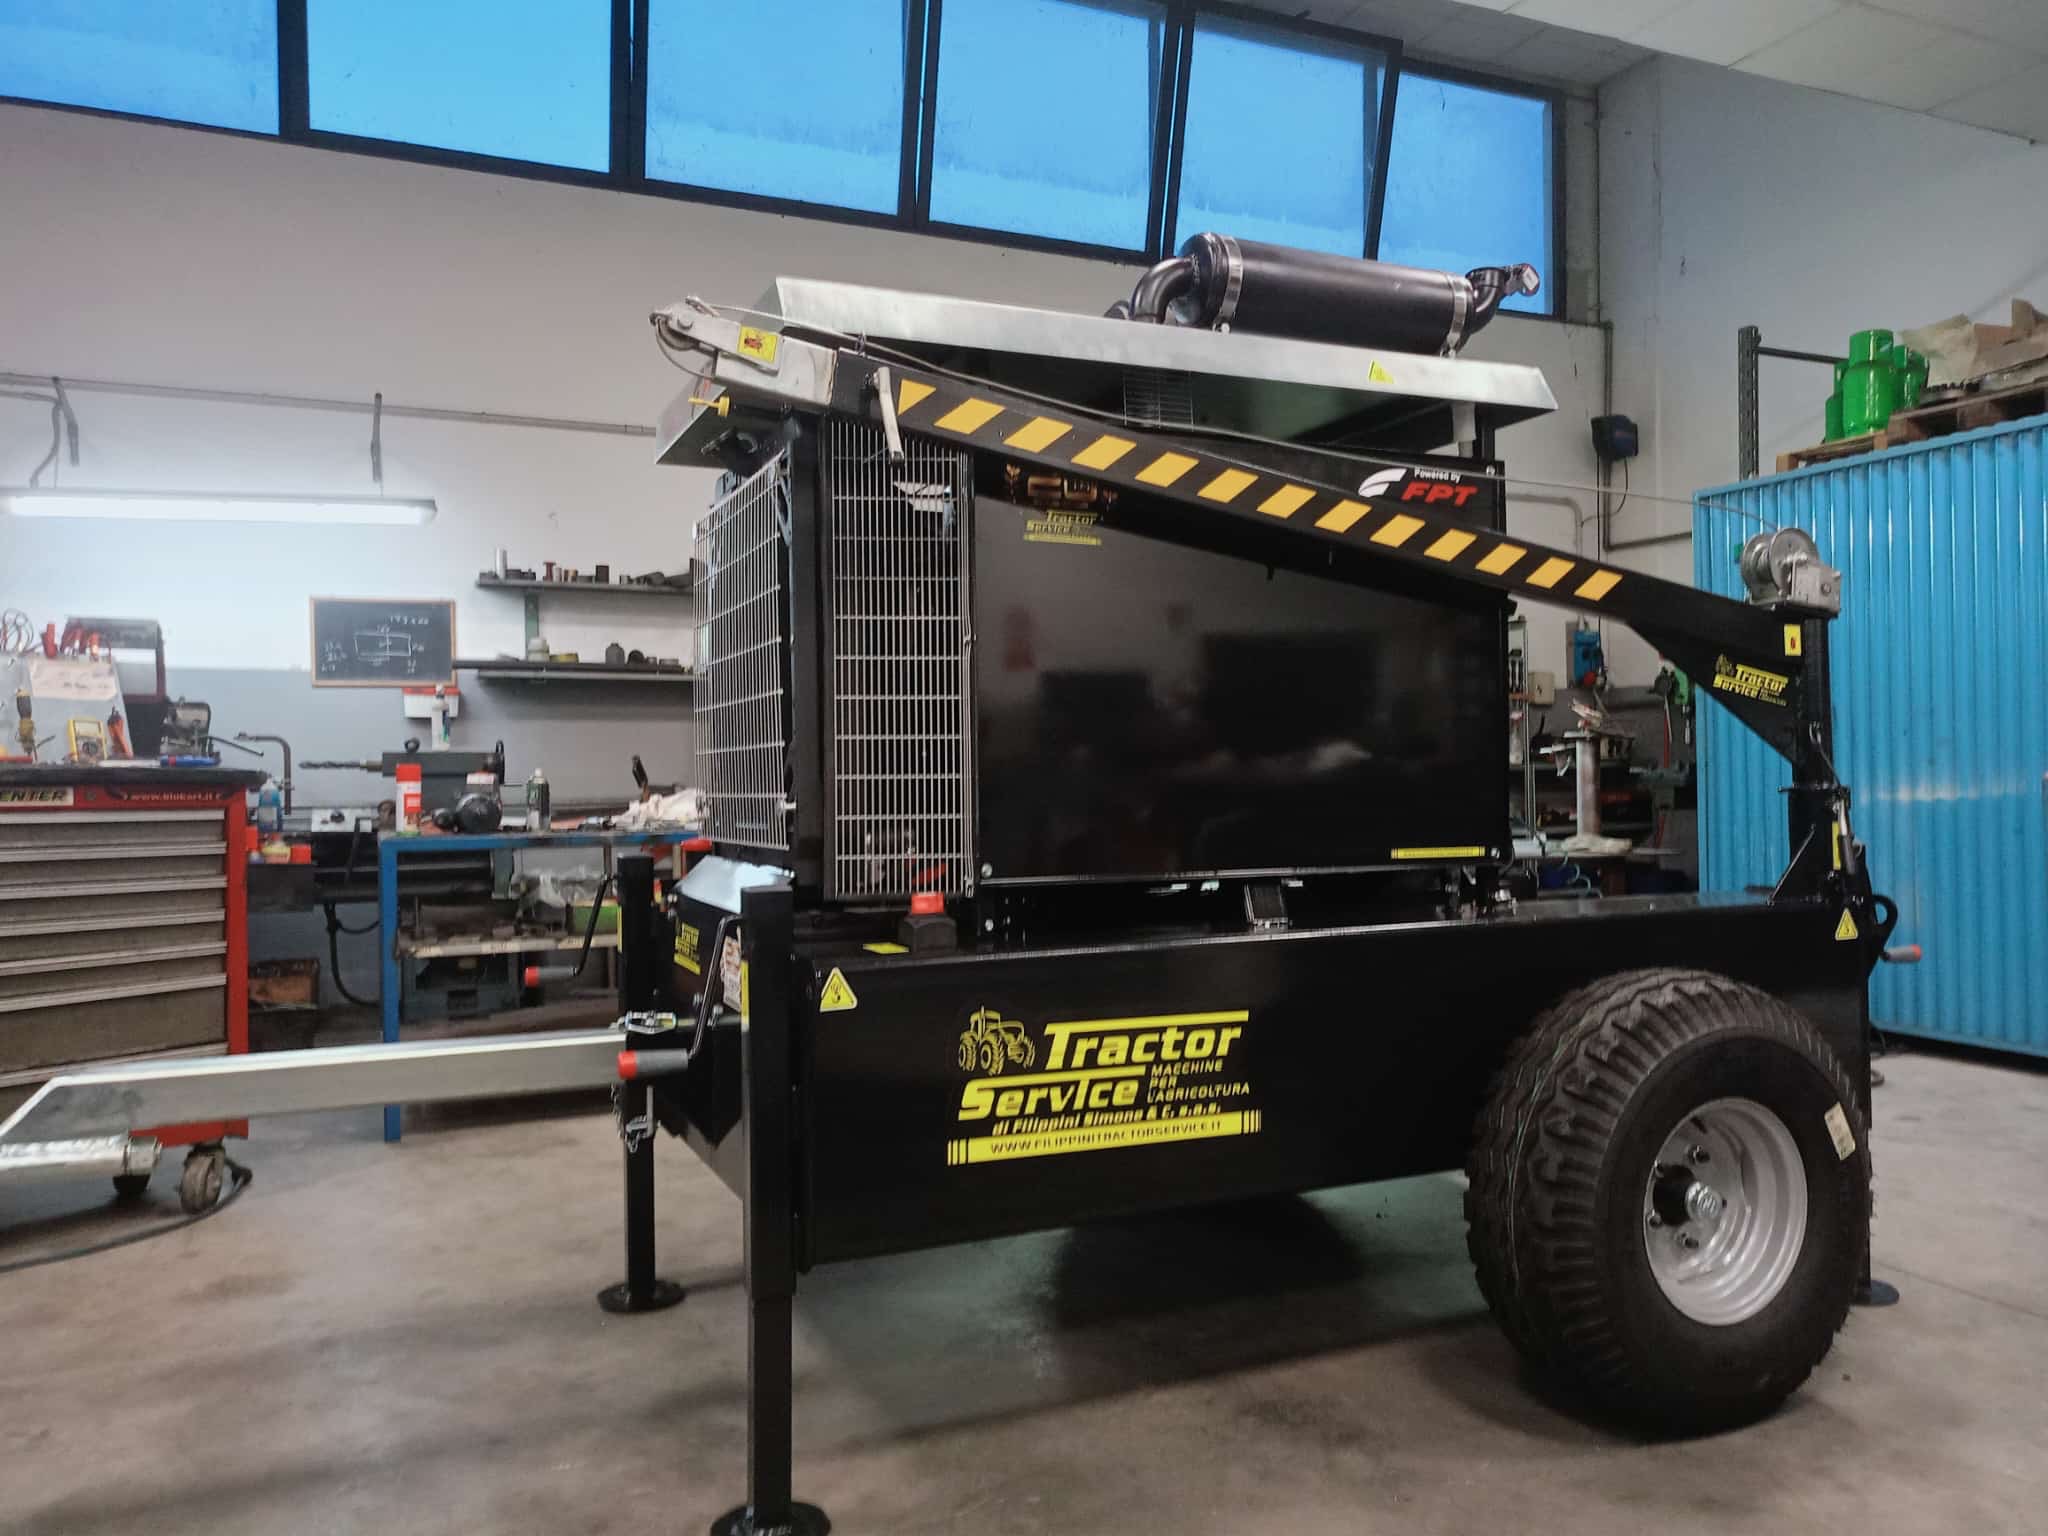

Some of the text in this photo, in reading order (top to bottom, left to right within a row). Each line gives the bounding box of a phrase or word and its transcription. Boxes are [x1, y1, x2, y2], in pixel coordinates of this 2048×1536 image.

[1413, 466, 1461, 483] Powered by
[1401, 481, 1478, 507] FPT
[1712, 673, 1760, 698] Service
[1735, 663, 1789, 693] Tractor
[1045, 1009, 1249, 1070] Tractor
[1151, 1058, 1224, 1077] MACCHINE
[958, 1064, 1146, 1121] Service
[1147, 1081, 1250, 1104] L'AGRICOLTURA
[1150, 1075, 1178, 1089] PER
[993, 1119, 1010, 1137] di
[1012, 1112, 1080, 1135] Filippini
